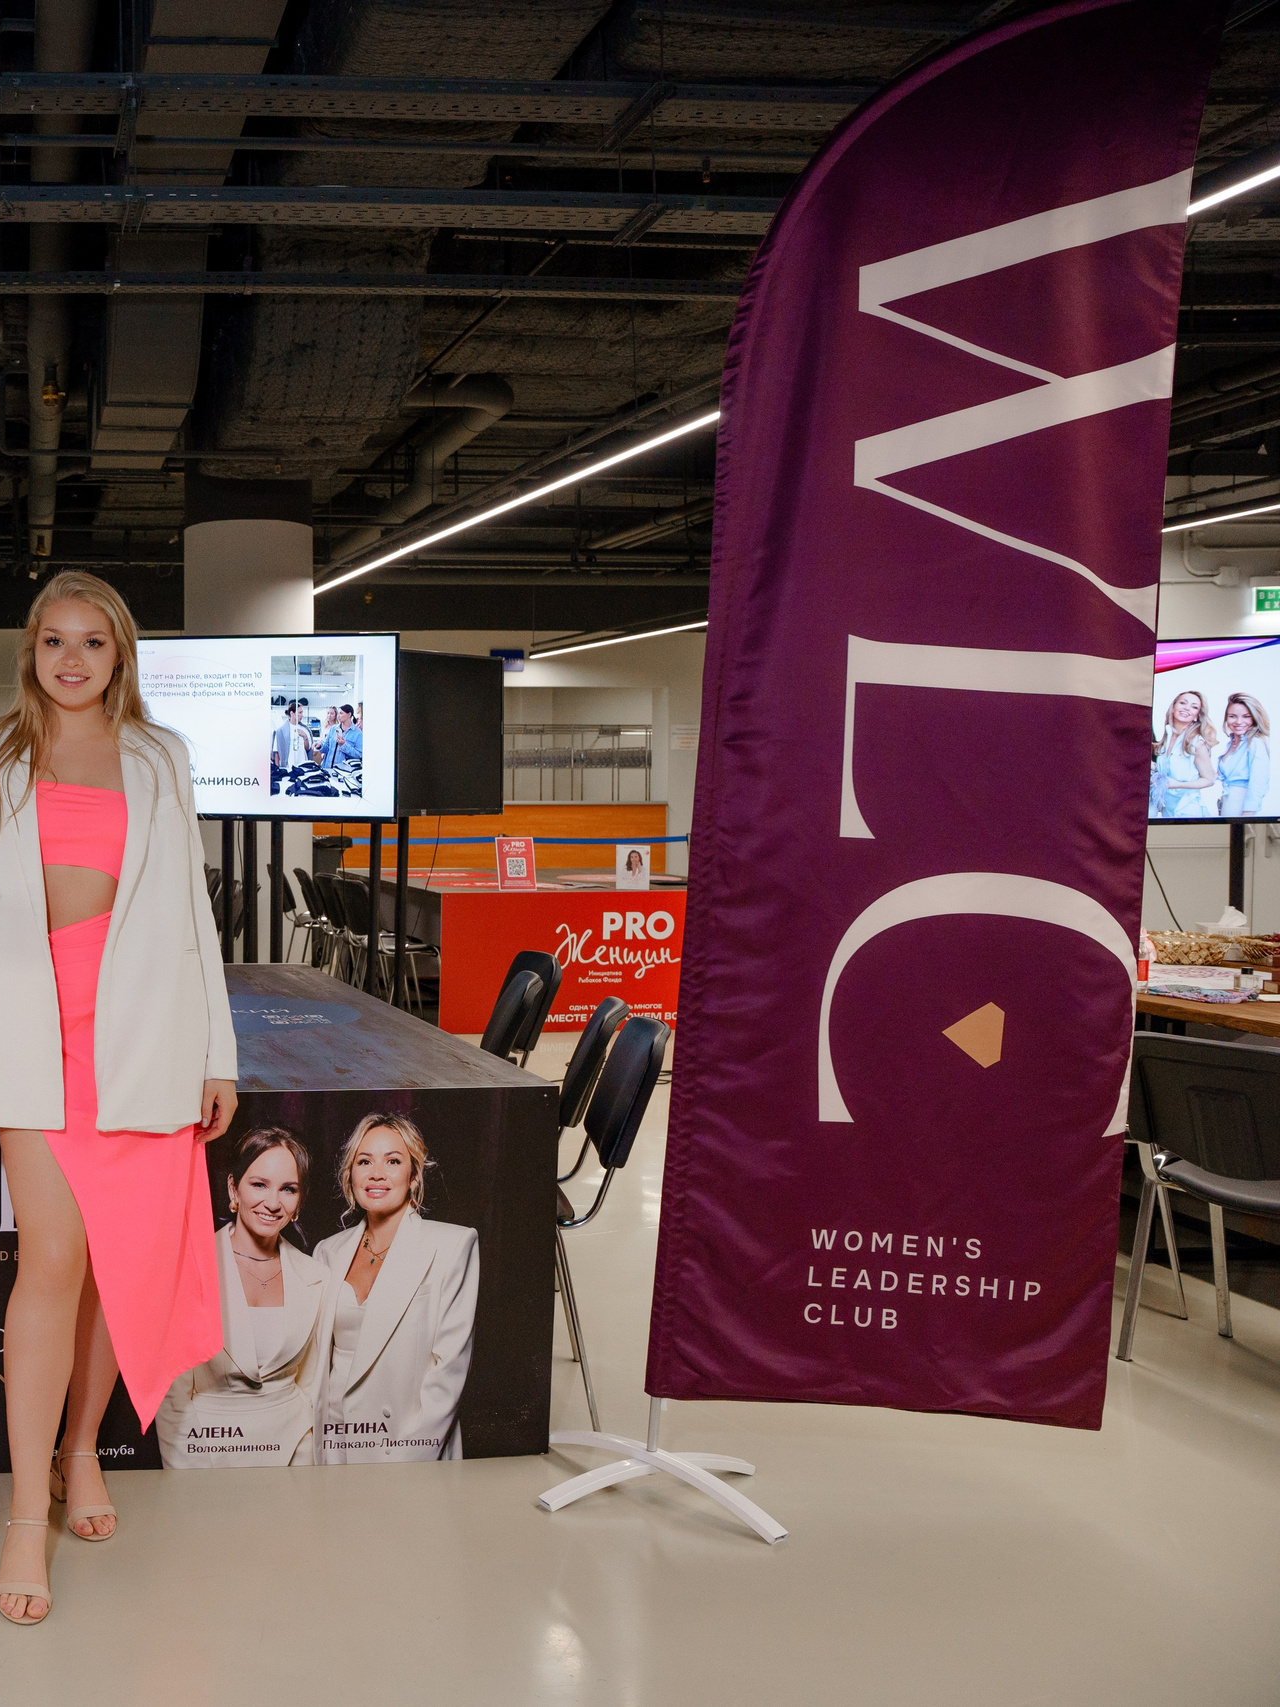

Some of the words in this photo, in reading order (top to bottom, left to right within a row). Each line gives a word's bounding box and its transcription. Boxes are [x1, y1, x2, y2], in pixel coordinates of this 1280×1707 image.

[1259, 592, 1280, 600] ВЫ
[817, 167, 1194, 1137] WLC
[189, 681, 223, 689] брендов
[191, 690, 226, 698] фабрика
[602, 910, 675, 940] PRO
[555, 923, 681, 979] Женщин
[578, 976, 602, 984] Рыбаков
[811, 1228, 982, 1259] WOMEN'S
[807, 1266, 1042, 1301] LEADERSHIP
[803, 1303, 898, 1330] CLUB
[187, 1426, 244, 1439] АЛЕНА
[323, 1422, 388, 1435] РЕГИНА
[187, 1442, 281, 1454] Воложанинова
[323, 1437, 440, 1451] Плакало-Листопад
[98, 1444, 135, 1459] клуба
